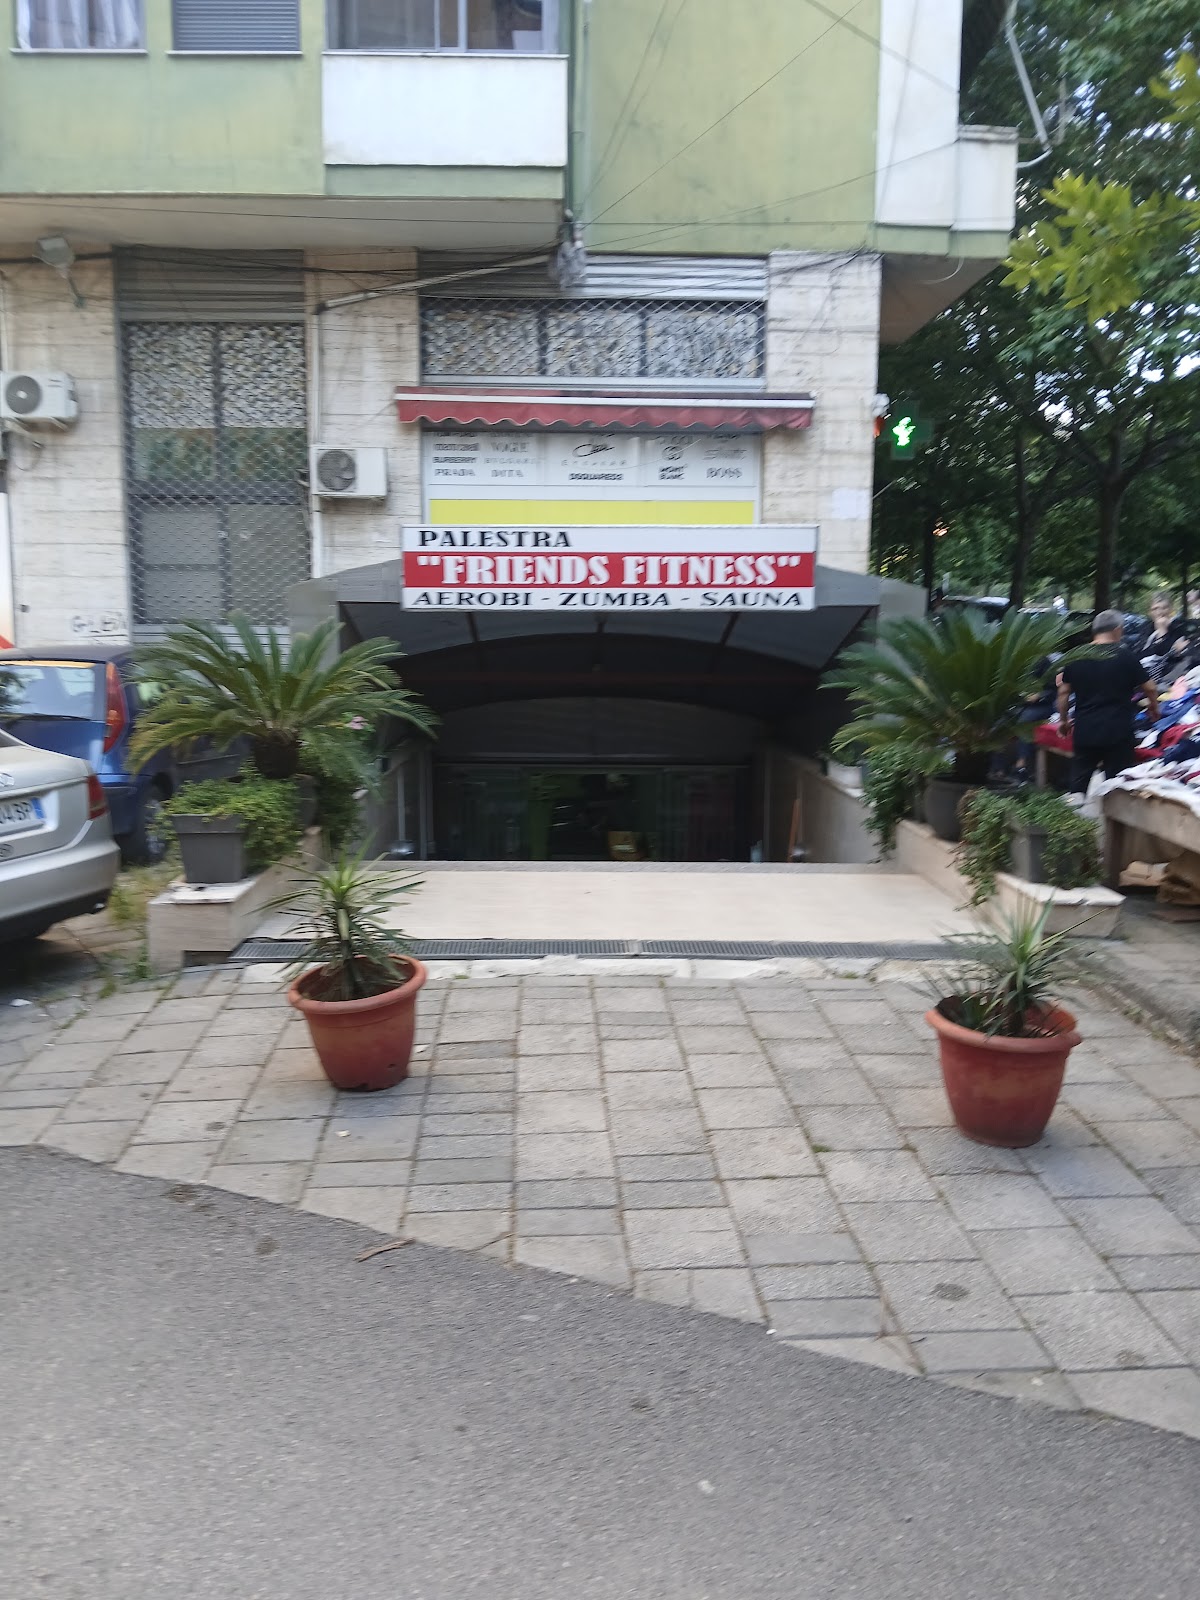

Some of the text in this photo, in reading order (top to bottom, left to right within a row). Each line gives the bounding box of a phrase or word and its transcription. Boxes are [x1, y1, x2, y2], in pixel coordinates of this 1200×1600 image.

[434, 468, 476, 476] PRADA
[418, 530, 572, 548] PALESTRA
[411, 592, 534, 606] AEROBI
[558, 591, 672, 607] ZUMBA
[700, 591, 804, 607] SAUNA
